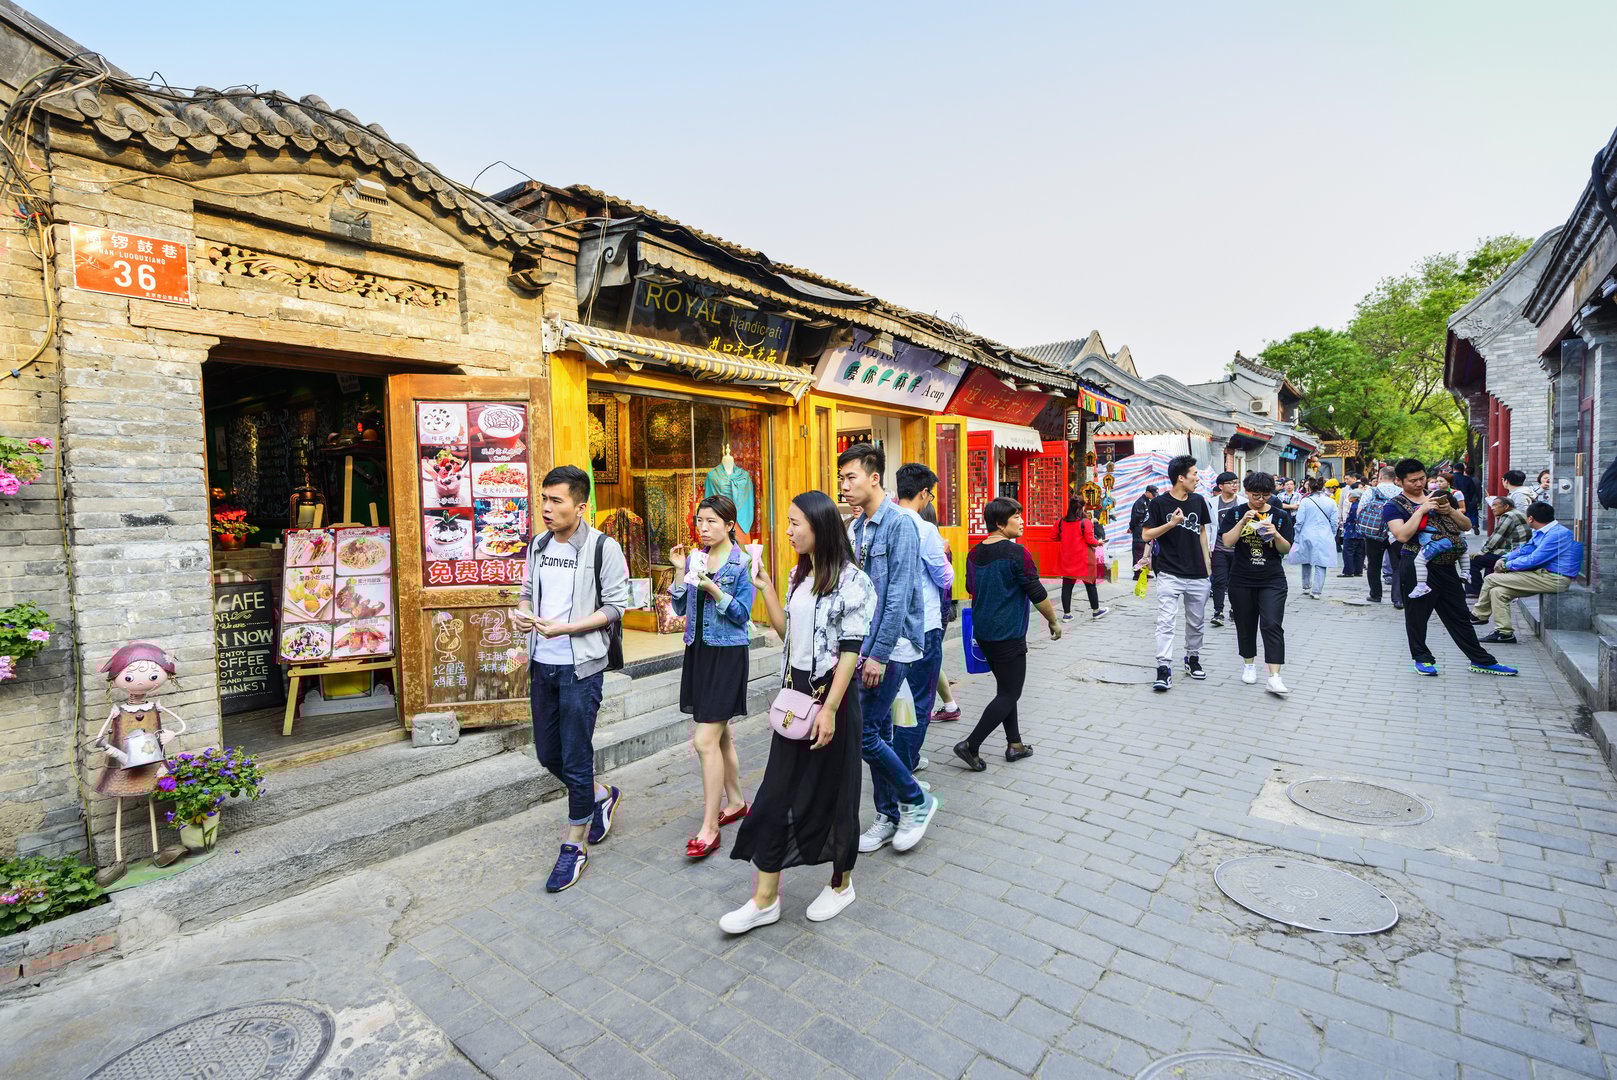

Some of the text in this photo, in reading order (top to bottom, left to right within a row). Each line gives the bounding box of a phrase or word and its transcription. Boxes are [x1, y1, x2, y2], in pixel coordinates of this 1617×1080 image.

[99, 248, 166, 265] NAN LUOGUXIANG
[113, 260, 157, 291] 36
[645, 283, 783, 340] ROYAL Handicraft
[707, 336, 777, 364] 进口手工艺品
[921, 384, 932, 397] A
[930, 388, 945, 403] cup
[428, 559, 527, 584] 免费续杯
[218, 591, 266, 612] CAFE
[233, 628, 274, 646] NOW
[219, 650, 246, 659] ENJOY
[249, 665, 269, 676] ICE
[433, 660, 466, 676] 12星座
[434, 674, 467, 688] 鸡尾酒
